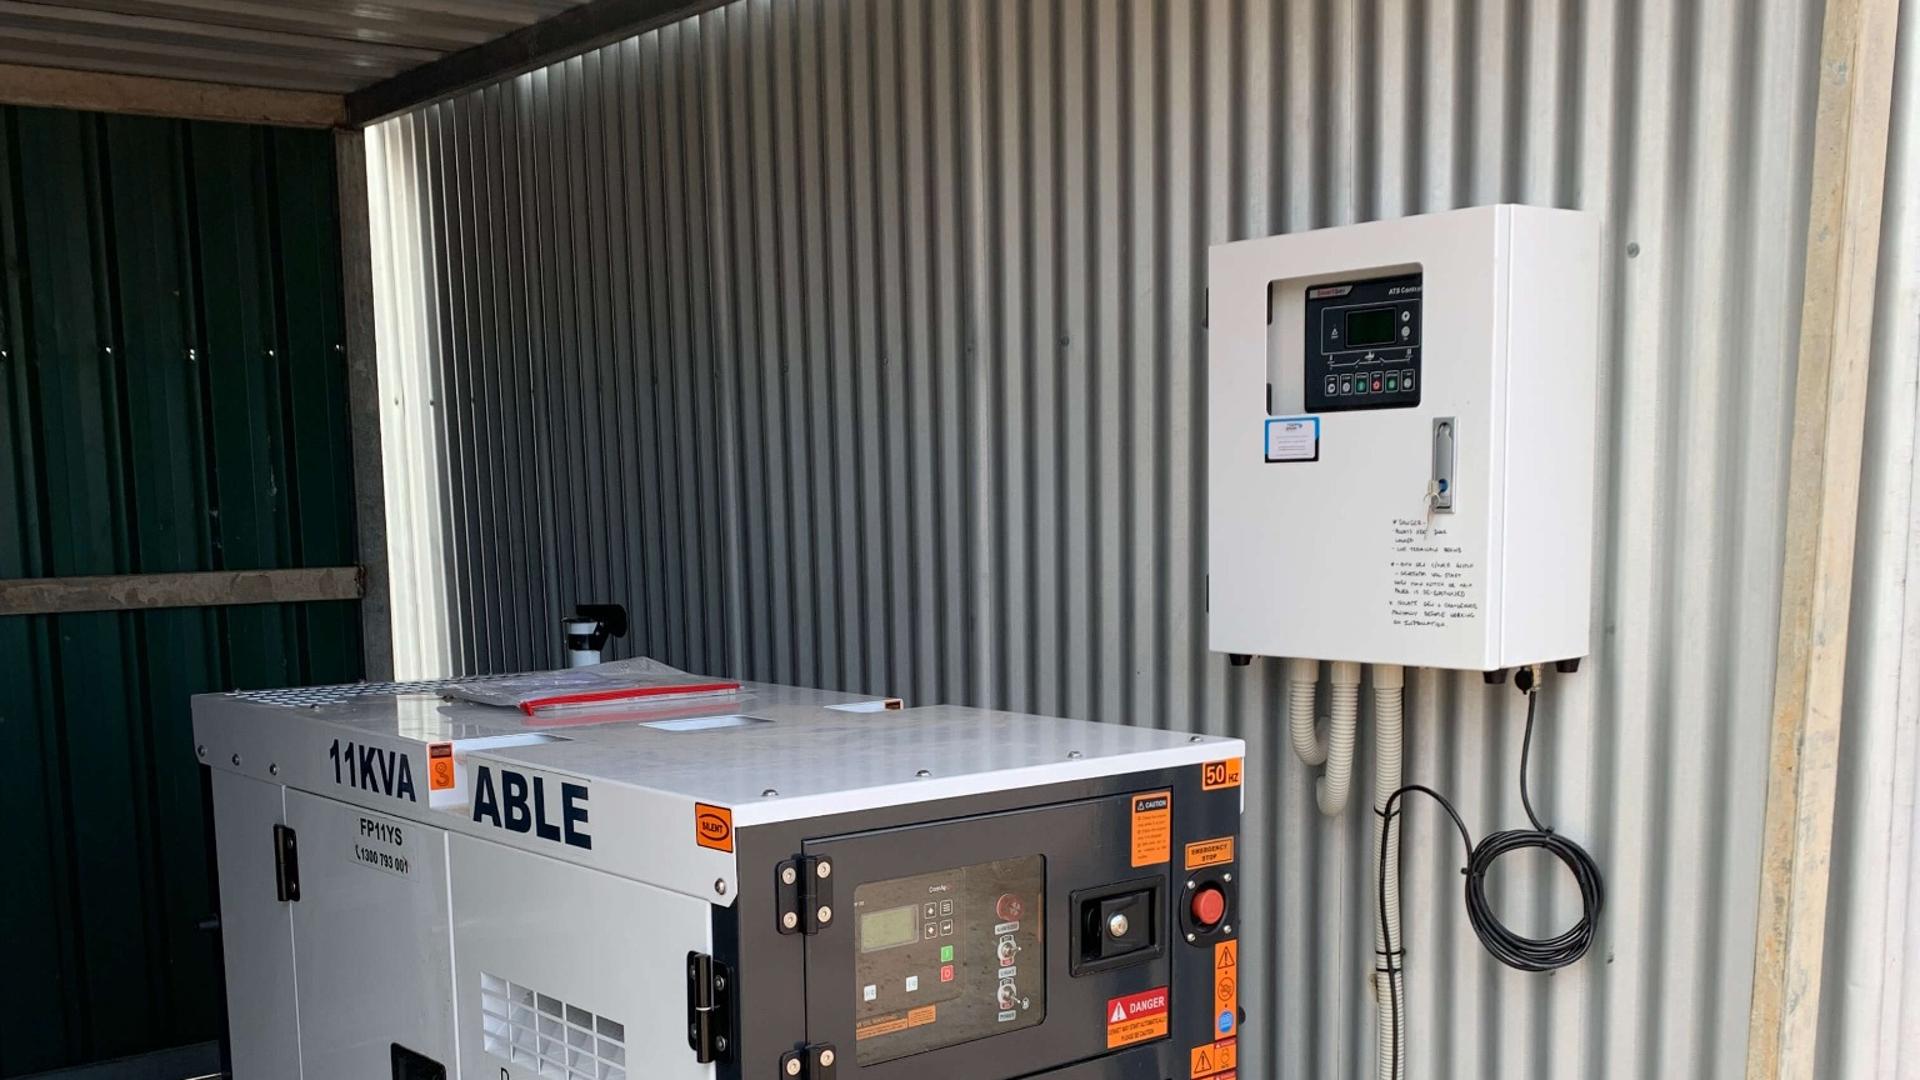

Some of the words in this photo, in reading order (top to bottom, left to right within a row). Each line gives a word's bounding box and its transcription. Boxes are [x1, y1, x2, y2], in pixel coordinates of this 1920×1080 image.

[329, 738, 416, 803] 11KVA
[1206, 764, 1225, 785] 50
[472, 765, 592, 850] ABLE
[1145, 800, 1166, 809] CAUTION
[360, 818, 403, 846] FP11YS
[702, 821, 722, 833] SILENT
[1191, 843, 1228, 855] EMERGENCY
[1202, 854, 1217, 862] STOP
[361, 847, 378, 864] 1300
[380, 852, 393, 869] 793
[395, 857, 408, 874] 001
[1129, 996, 1165, 1014] DANGER
